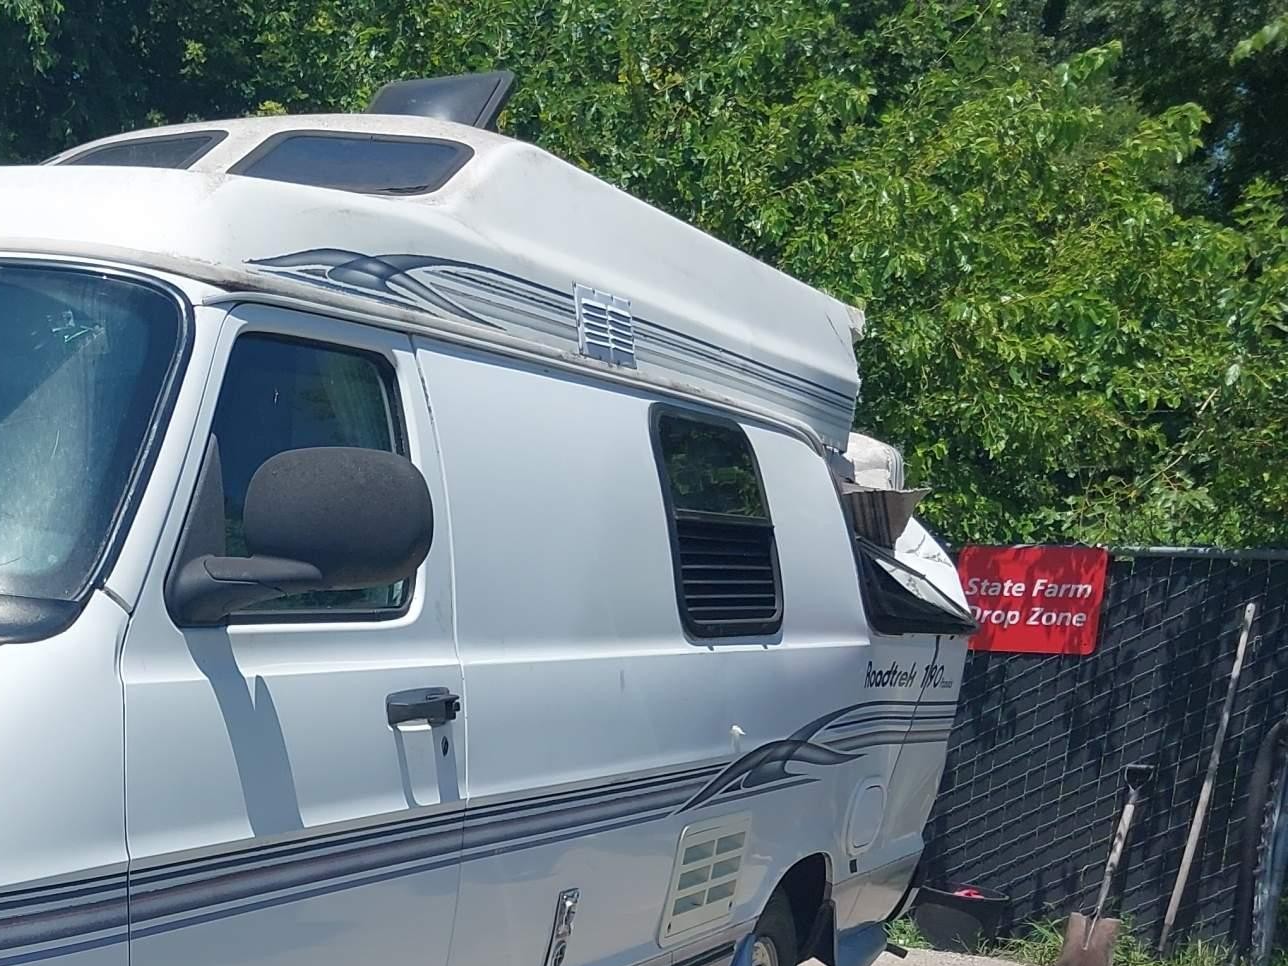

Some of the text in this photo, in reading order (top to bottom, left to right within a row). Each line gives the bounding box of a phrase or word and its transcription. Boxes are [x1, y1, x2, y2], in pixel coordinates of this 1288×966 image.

[965, 578, 1092, 598] State Farm
[969, 606, 1087, 628] Drop Zone
[864, 660, 917, 688] Roadtrek
